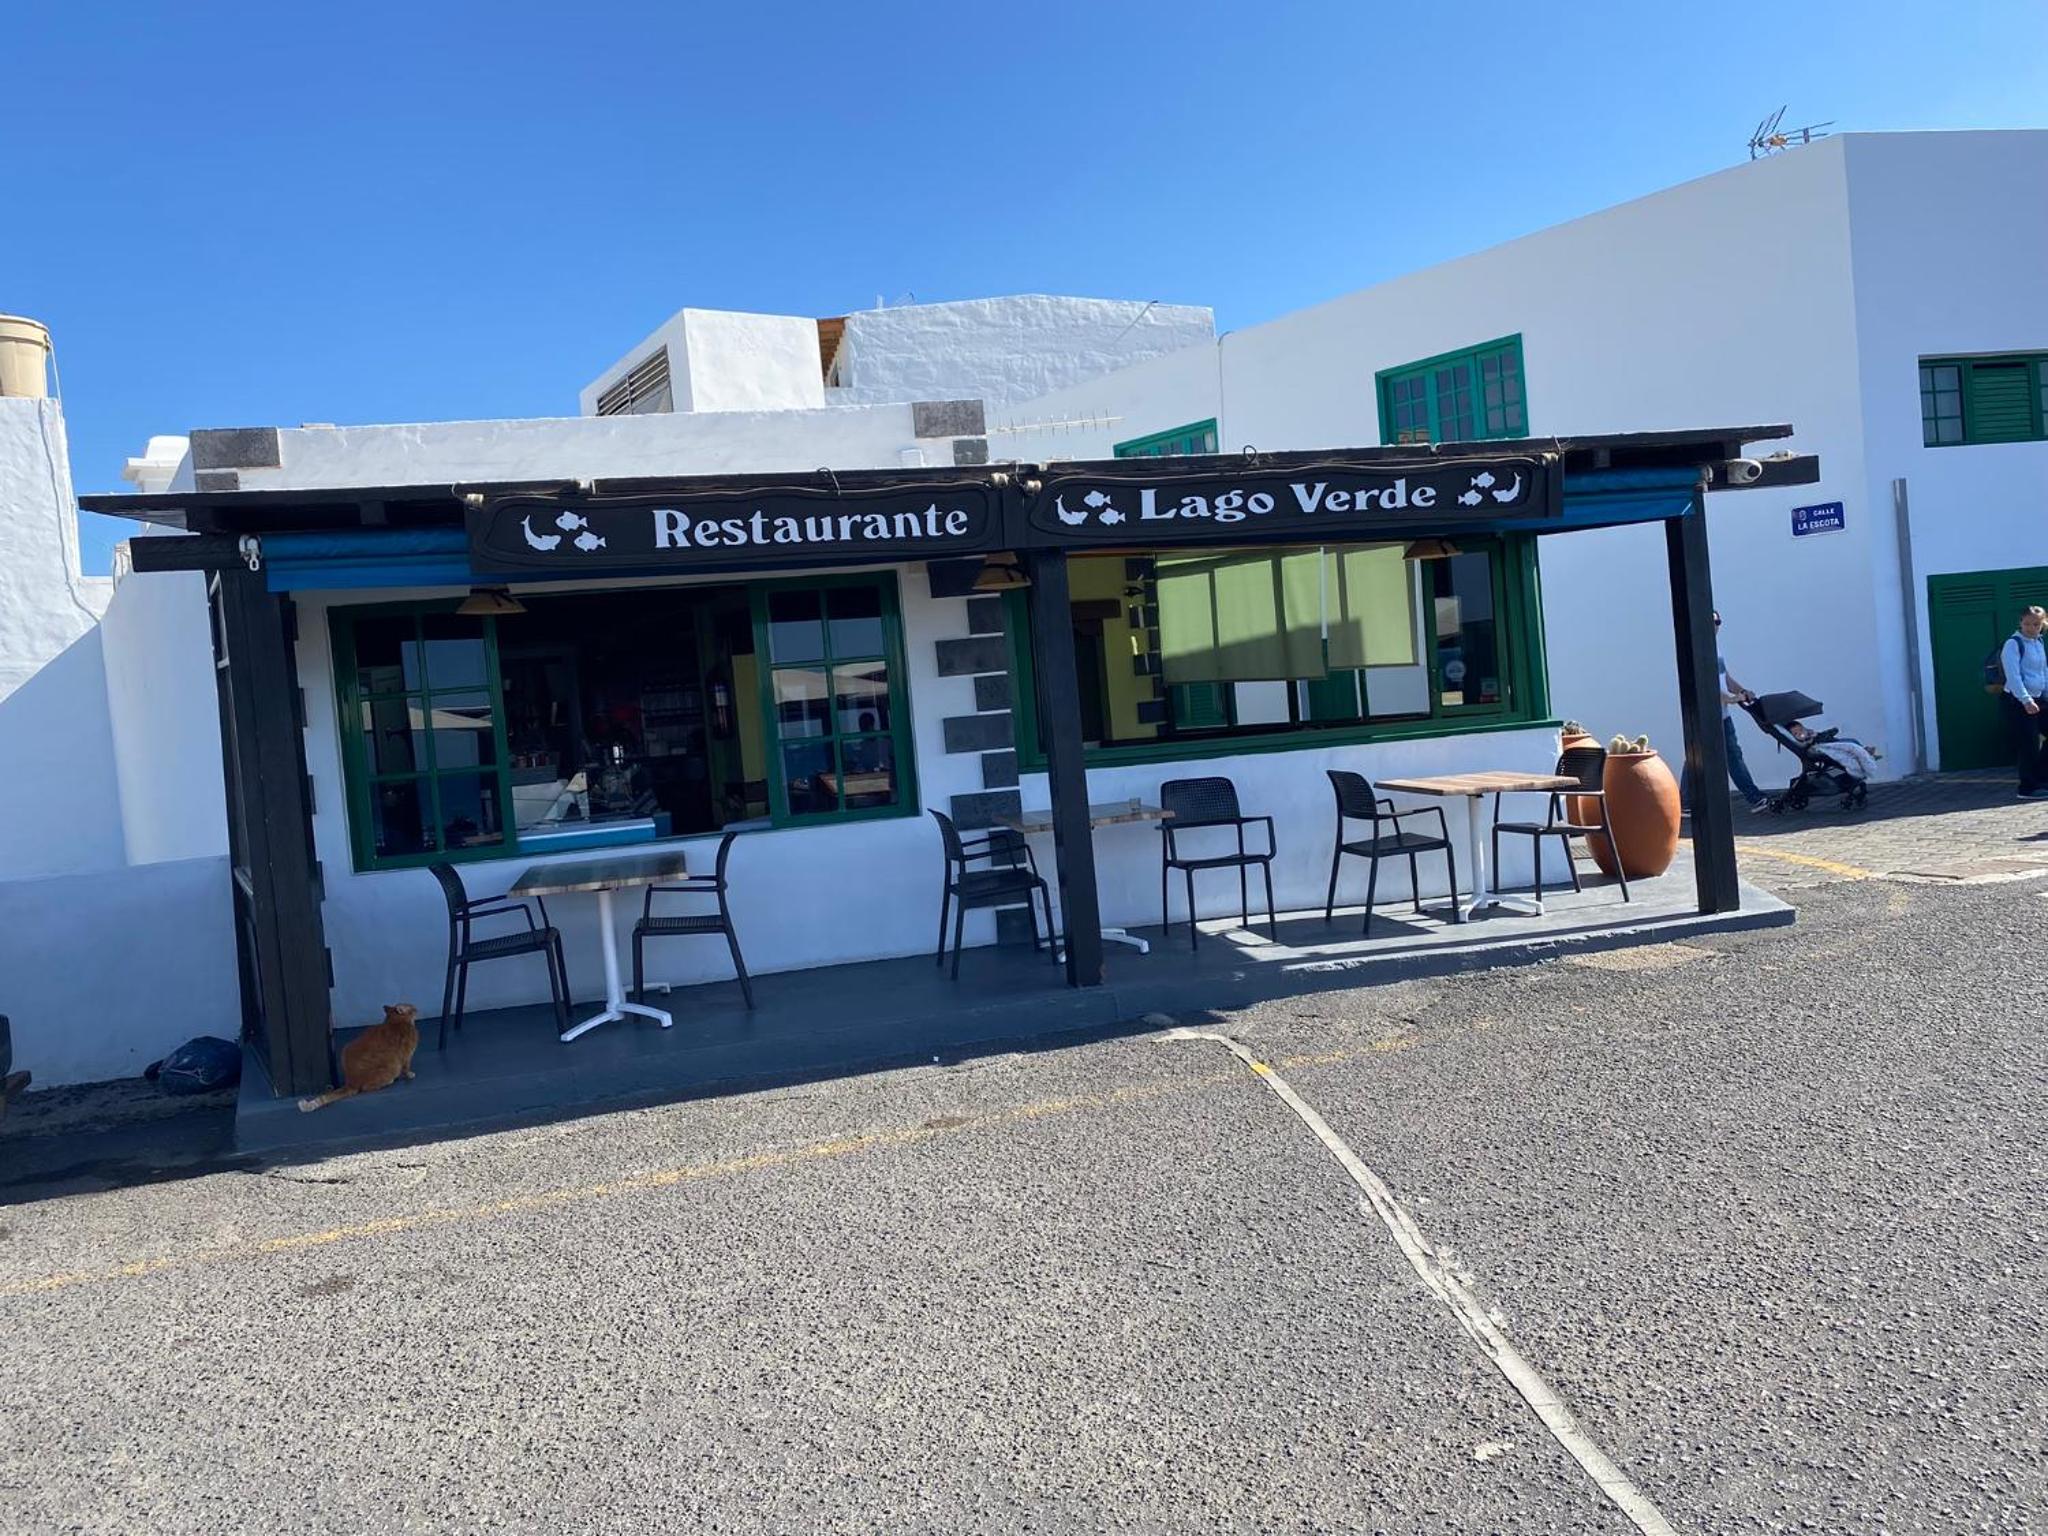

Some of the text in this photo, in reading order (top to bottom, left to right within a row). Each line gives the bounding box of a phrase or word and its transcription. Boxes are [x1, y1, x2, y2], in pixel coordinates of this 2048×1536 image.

[652, 478, 1437, 548] Restaurante Lago Verde
[1813, 508, 1835, 516] CALLE
[1797, 518, 1840, 530] LA ESCOTA
